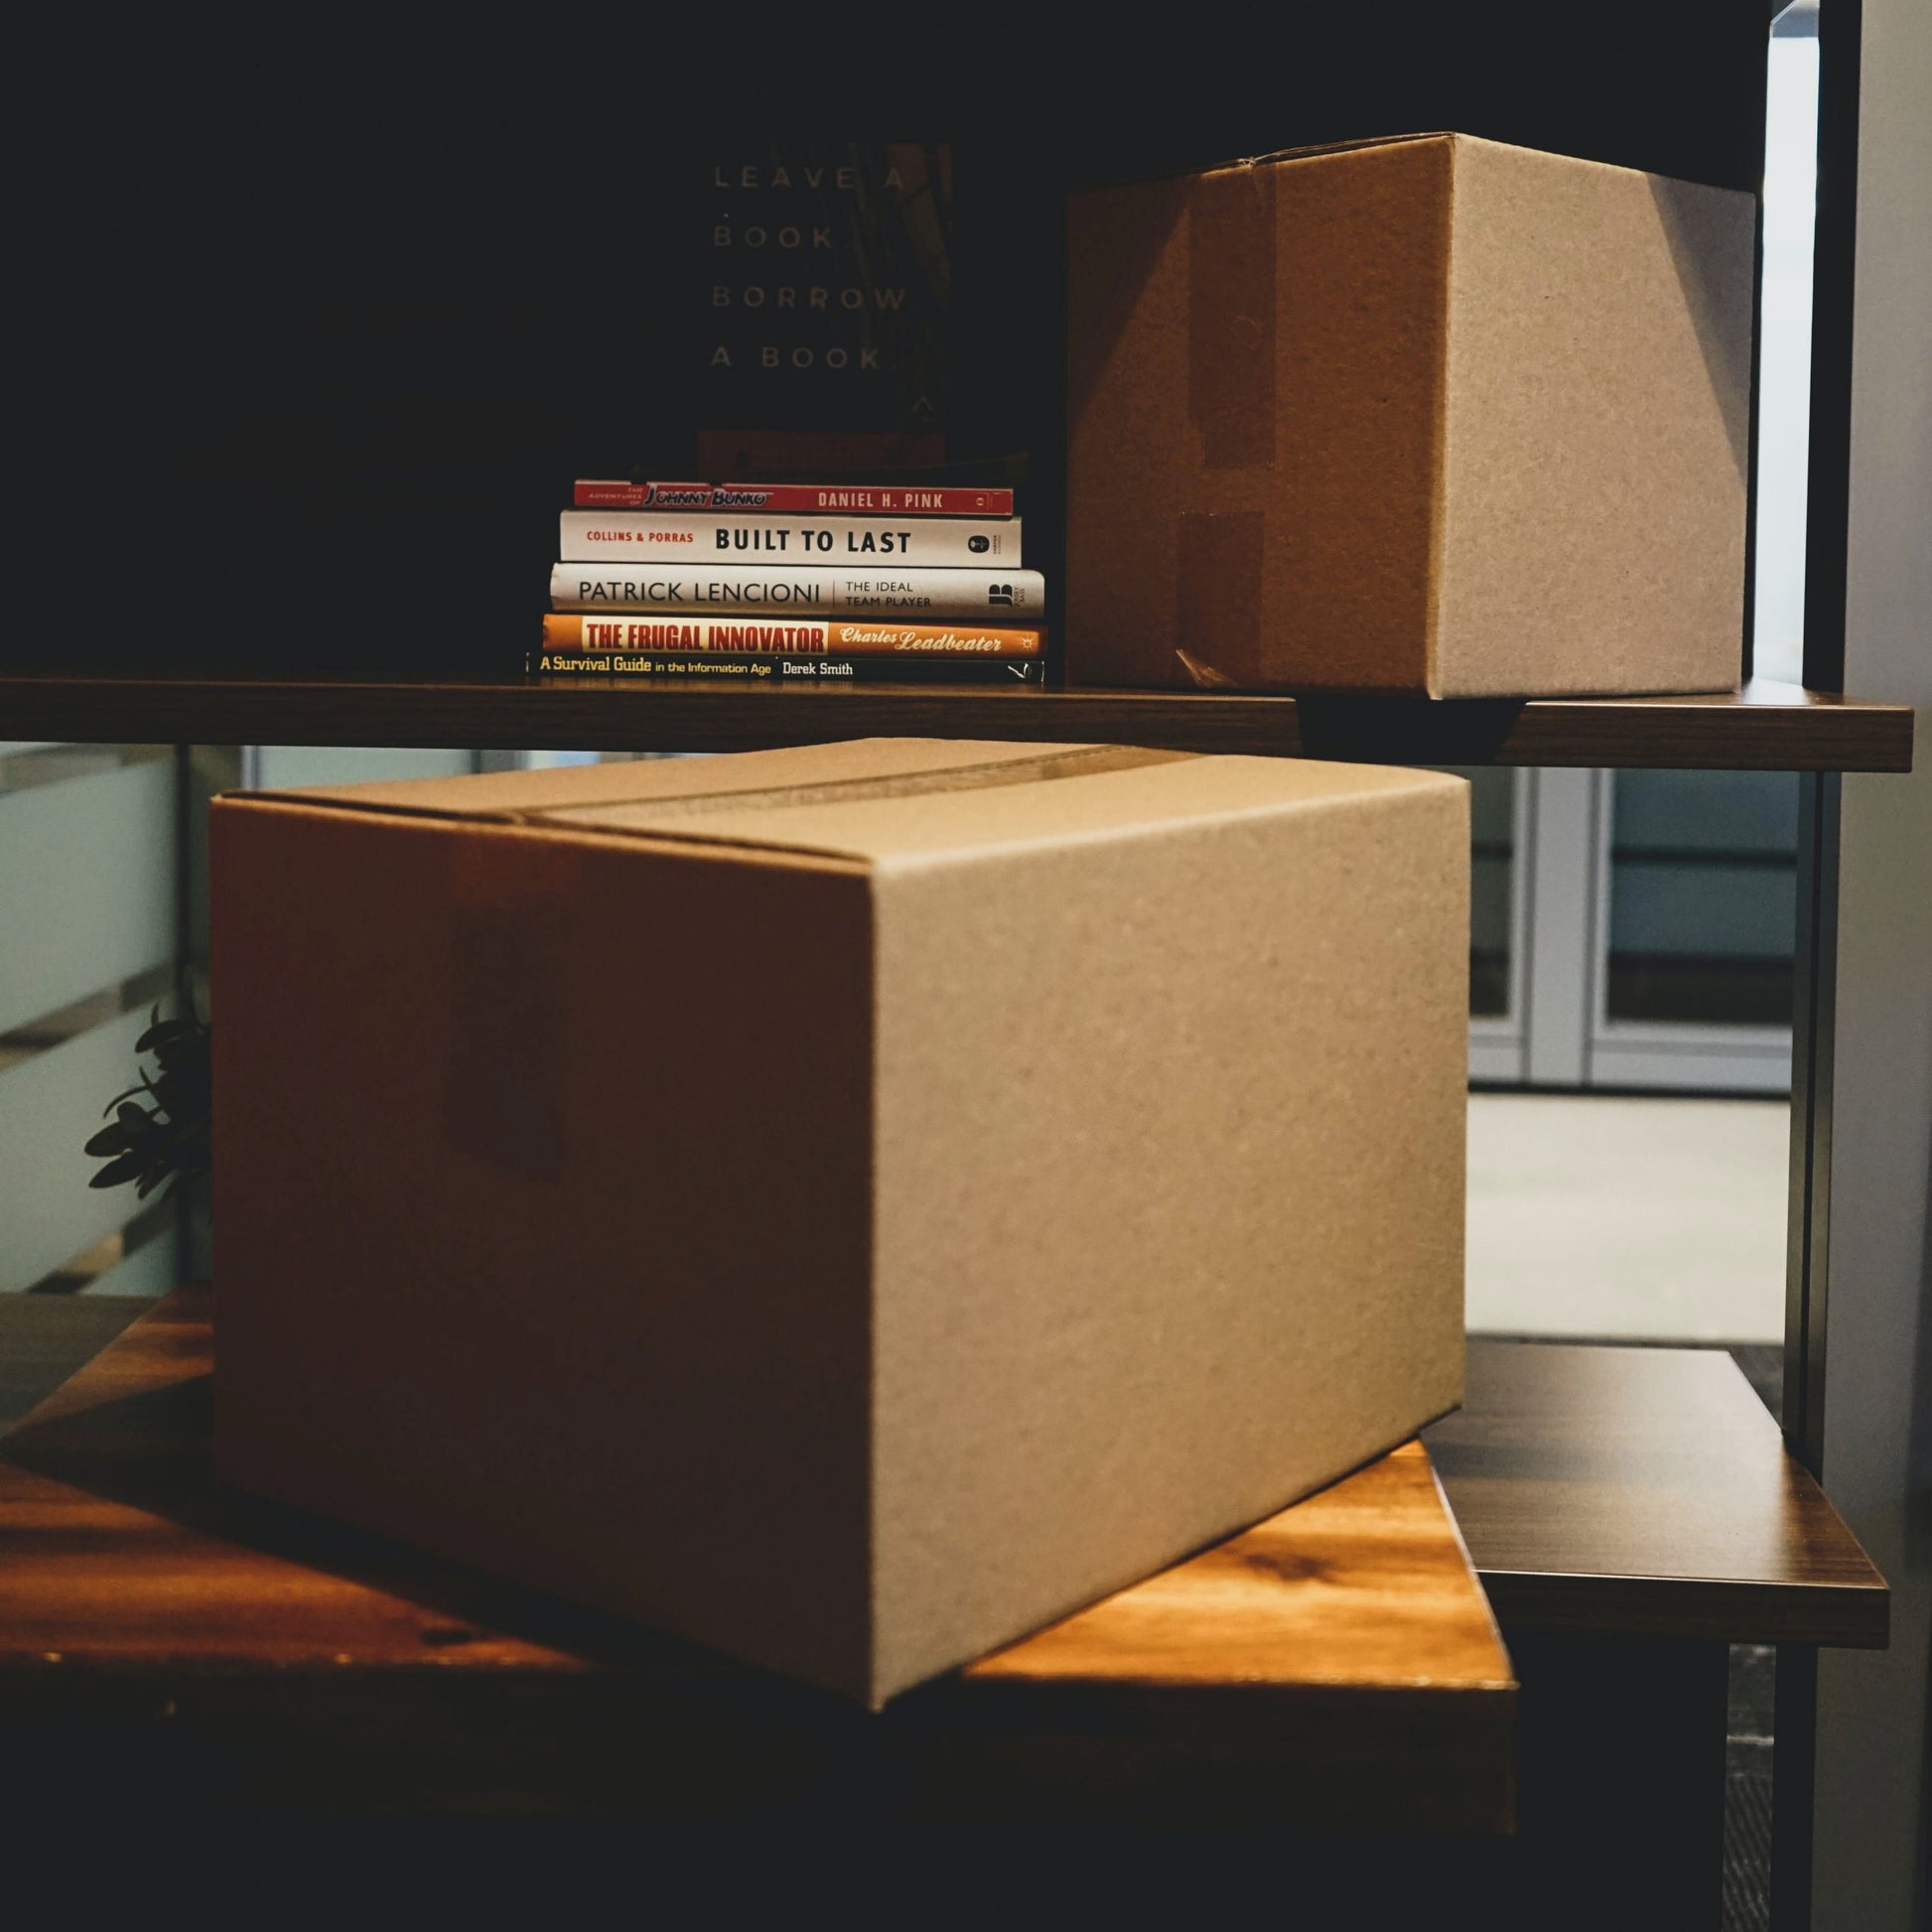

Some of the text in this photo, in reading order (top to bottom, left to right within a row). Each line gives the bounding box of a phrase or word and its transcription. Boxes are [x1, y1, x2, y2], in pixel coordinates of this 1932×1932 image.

[714, 165, 904, 190] LEAVE A
[714, 225, 832, 249] BOOK
[712, 286, 906, 310] BORROW
[710, 345, 881, 369] A BOOK
[644, 483, 771, 506] JOHNNY BUNKO
[818, 491, 943, 508] DANIEL H. PINK
[587, 530, 694, 543] COLLINS & PORRAS
[716, 528, 911, 553] BUILT TO LAST
[579, 581, 820, 604] PATRICK LENCIONI
[846, 581, 913, 593] THE IDEAL
[846, 597, 932, 608] TEAM PLAYER
[587, 623, 824, 652] THE FRUGAL INNOVATOR
[840, 626, 1002, 652] Charles Leadbeater
[540, 655, 853, 676] A Survival Guide in the Information Age Derek Smith
